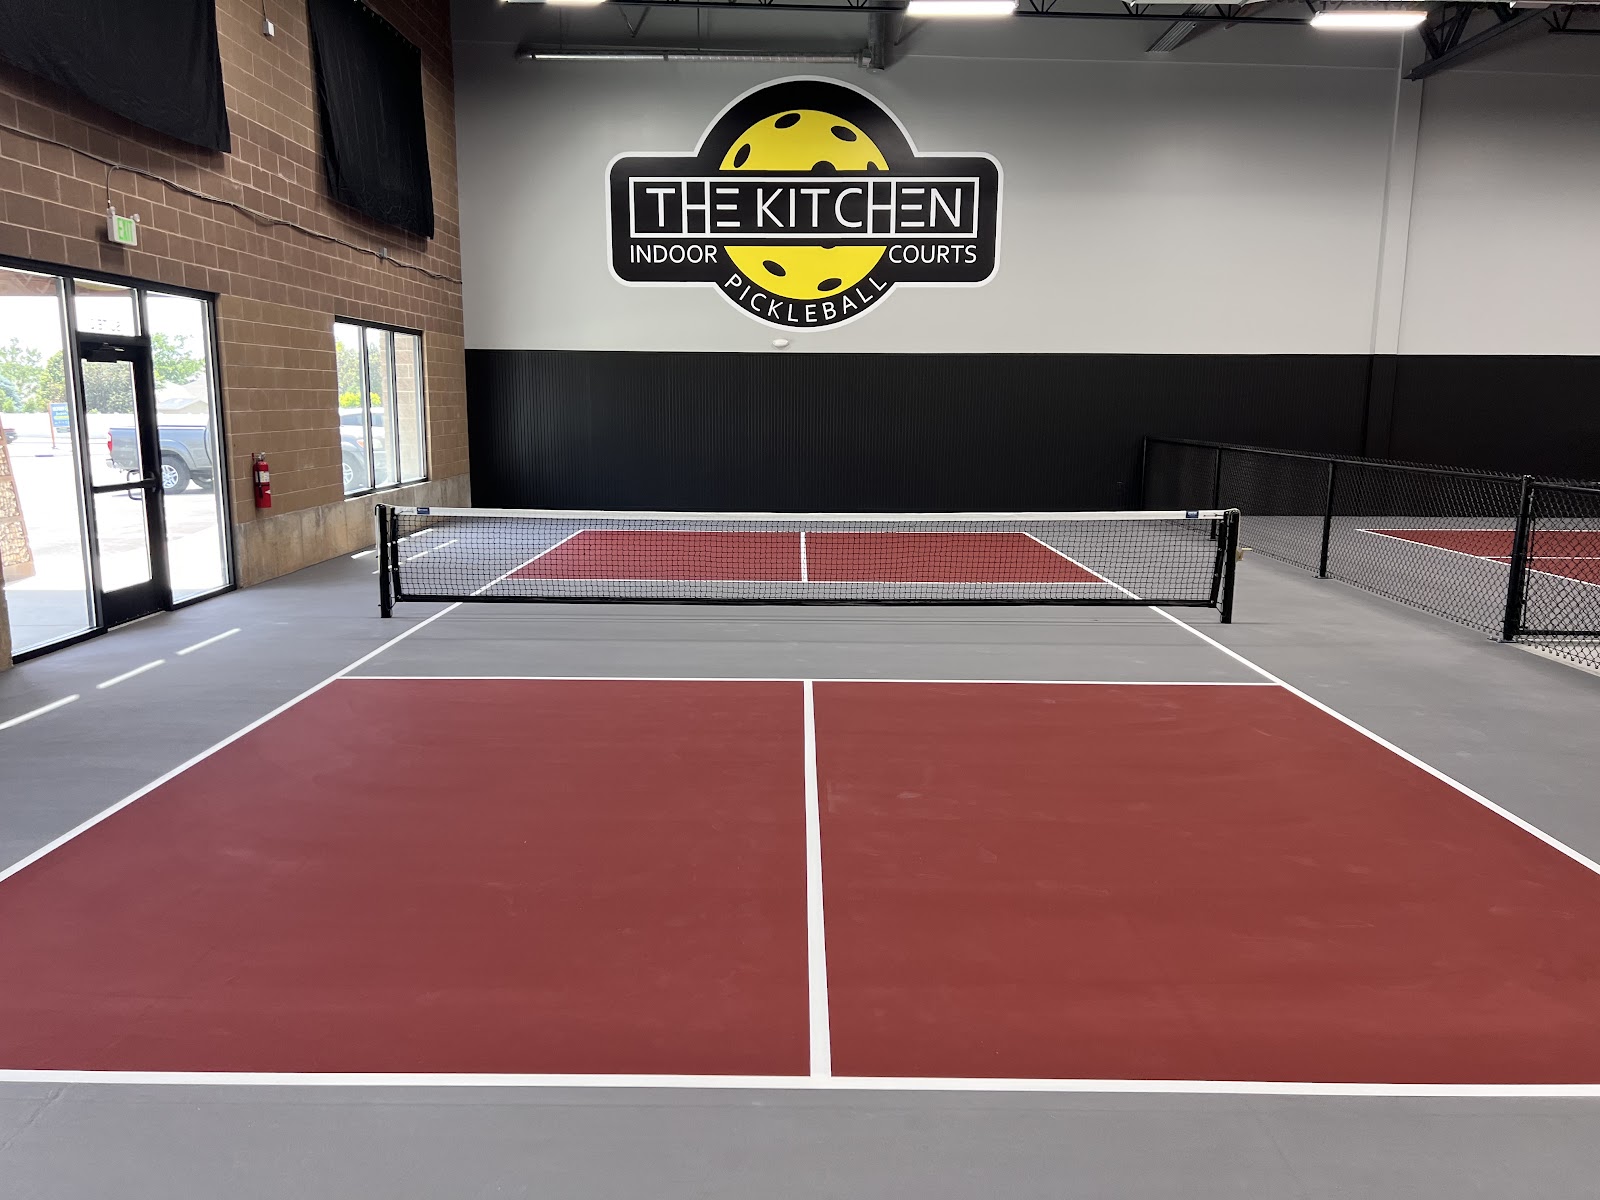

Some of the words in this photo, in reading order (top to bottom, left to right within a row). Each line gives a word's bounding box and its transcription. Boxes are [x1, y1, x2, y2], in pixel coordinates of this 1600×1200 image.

[645, 183, 742, 232] THE
[756, 183, 963, 232] KITCHEN
[117, 217, 134, 242] EXIT
[629, 244, 718, 264] INDOOR
[888, 244, 978, 264] COURTS
[724, 272, 888, 324] PICKLEBALL
